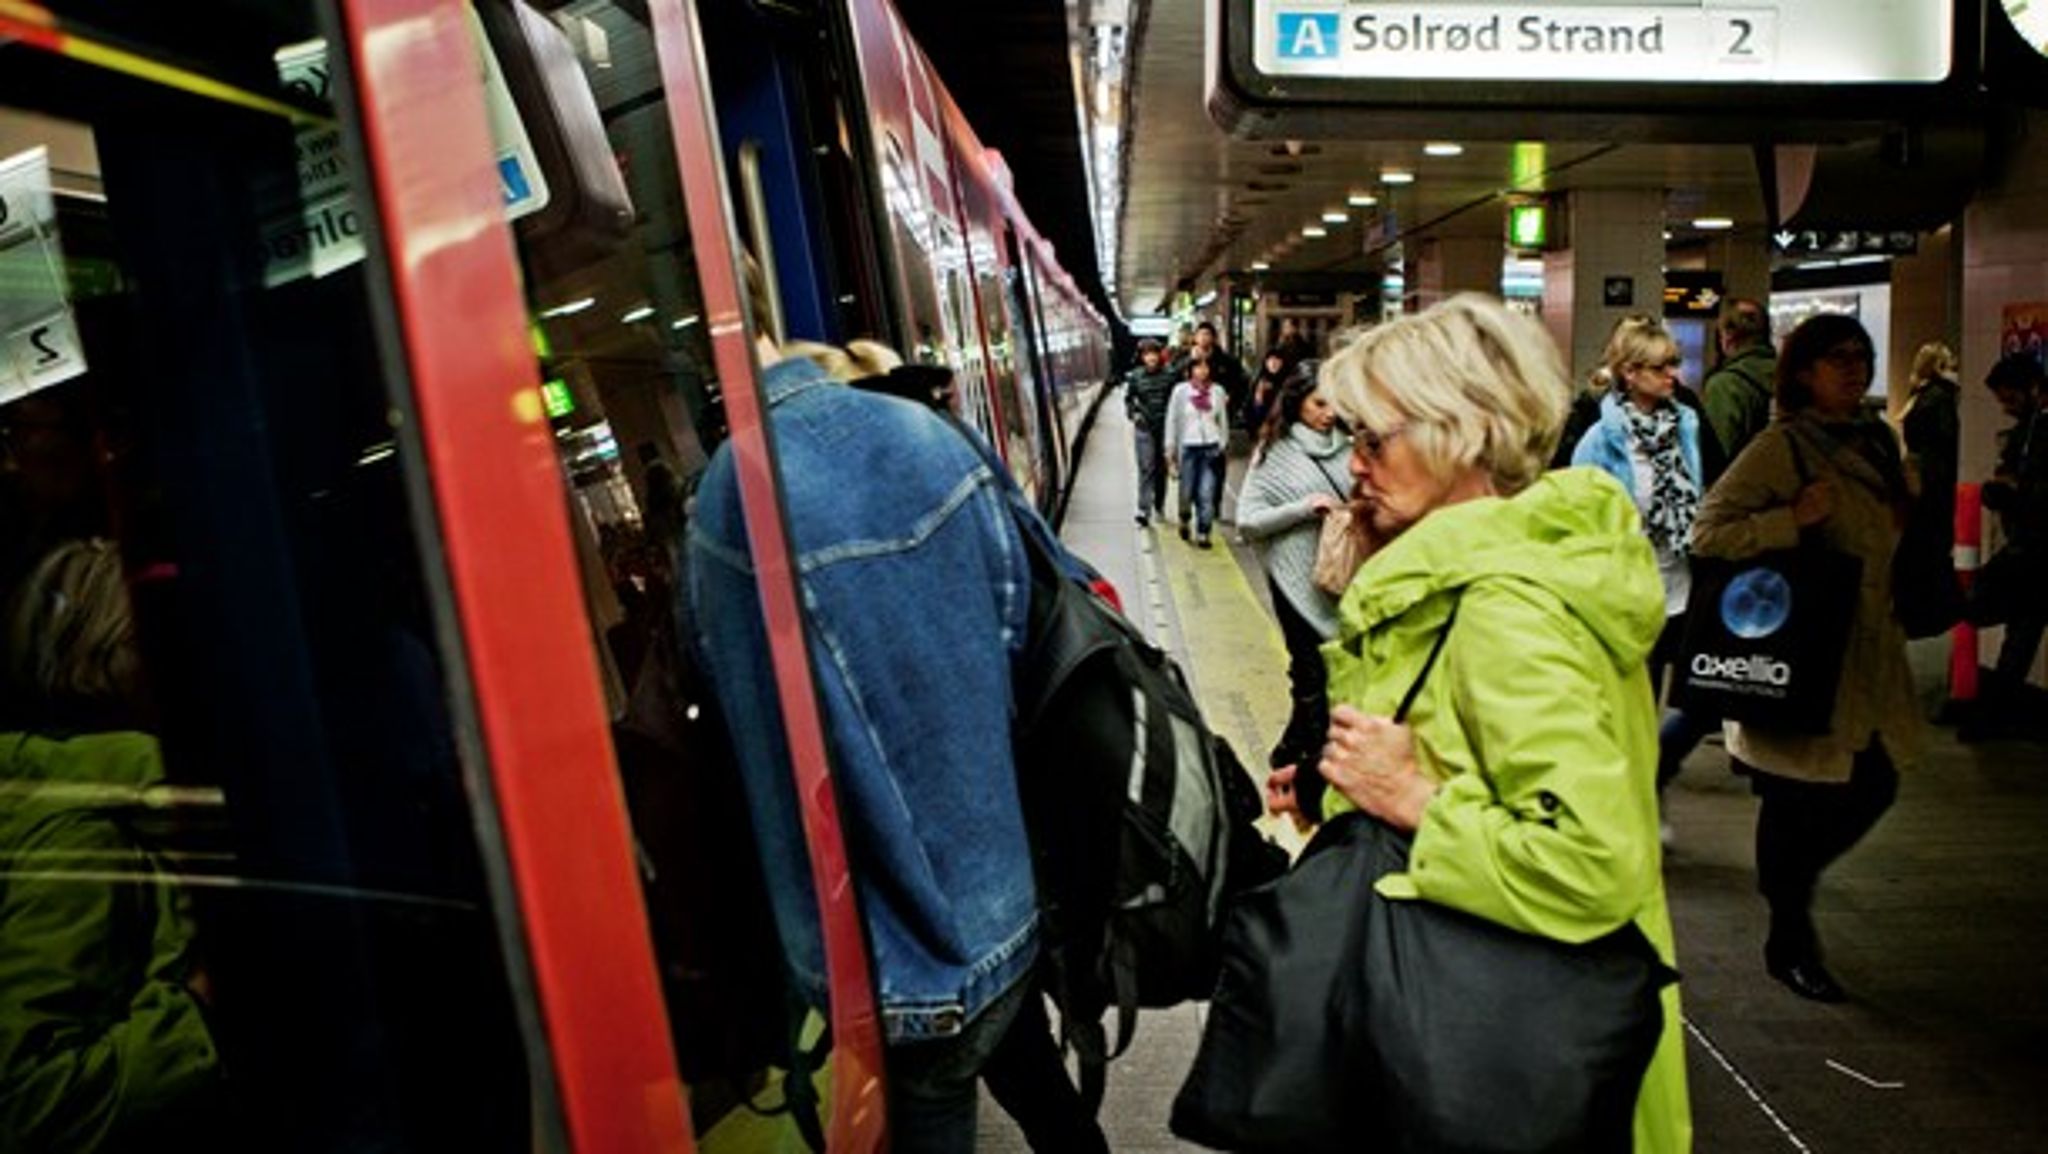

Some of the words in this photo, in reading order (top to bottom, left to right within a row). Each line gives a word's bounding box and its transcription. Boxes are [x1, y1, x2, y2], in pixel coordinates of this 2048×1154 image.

[1292, 19, 1325, 54] A
[1353, 15, 1500, 52] Solrød
[1517, 15, 1663, 54] Strand
[1728, 19, 1754, 55] 2
[1692, 654, 1790, 685] axellia
